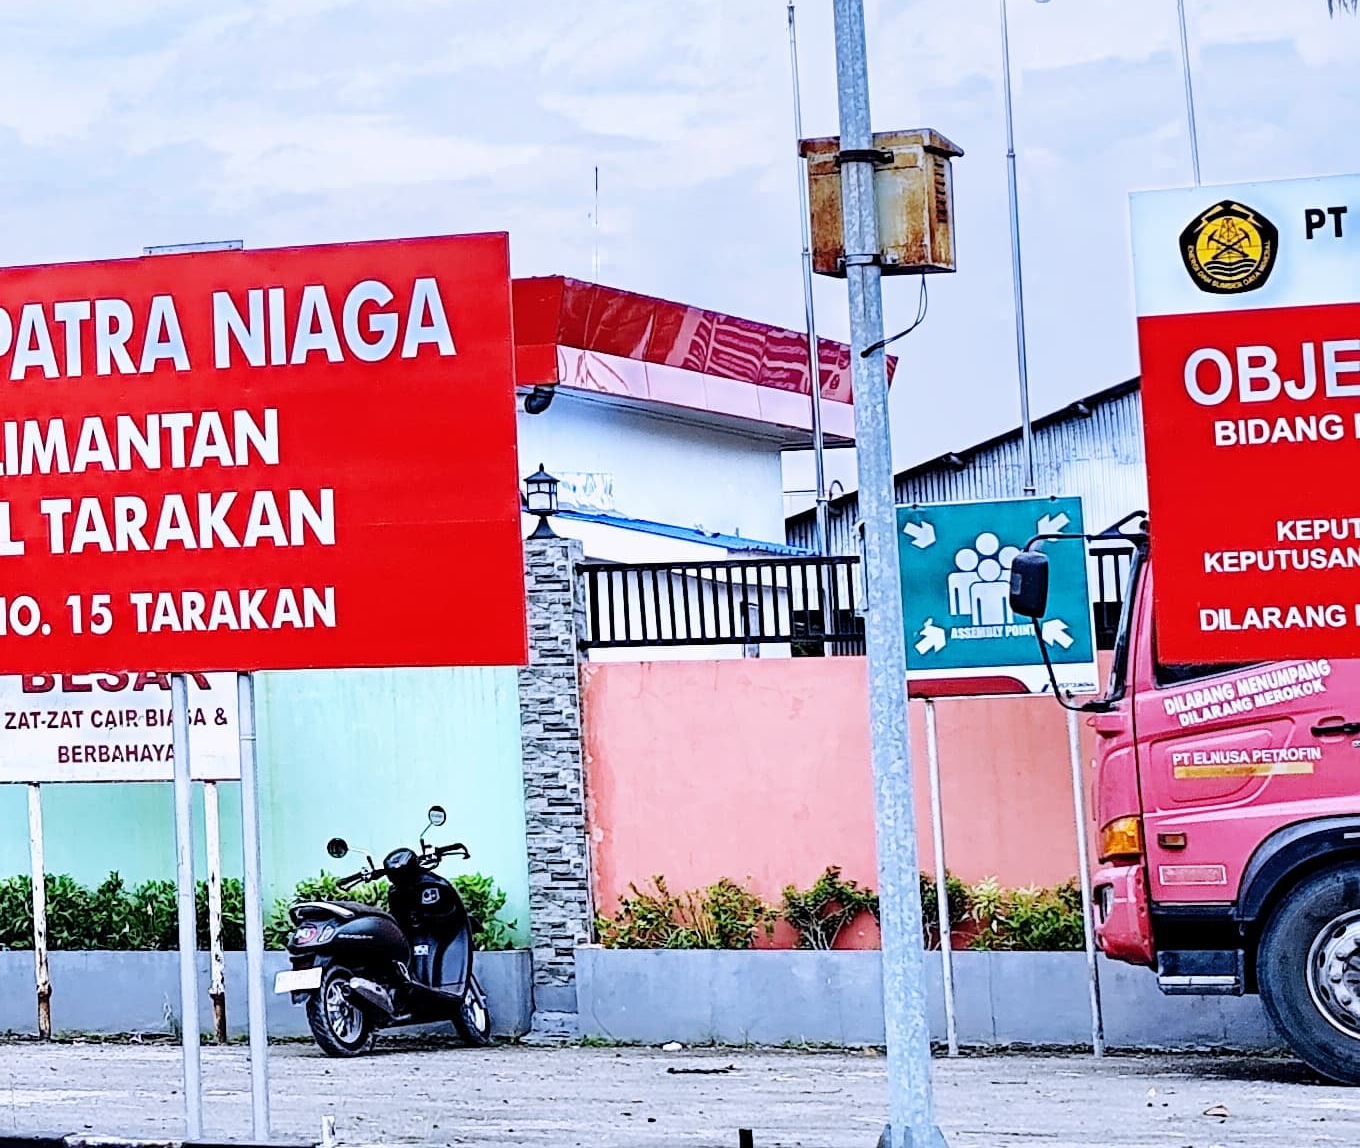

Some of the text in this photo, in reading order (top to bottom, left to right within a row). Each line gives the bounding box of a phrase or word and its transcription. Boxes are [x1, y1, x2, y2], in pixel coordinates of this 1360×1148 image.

[1305, 206, 1347, 239] PT
[213, 277, 457, 369] NIAGA
[1214, 414, 1344, 447] BIDANG
[41, 488, 336, 555] TARAKAN
[1204, 548, 1360, 574] KEPUTUSAN
[67, 593, 113, 635] 15
[131, 586, 336, 633] TARAKAN
[1199, 605, 1346, 632] DILARANG
[951, 625, 1003, 639] ASSEMBLY
[1164, 659, 1331, 715] DILARANG MENUMPANG
[1179, 679, 1326, 727] DILARANG MEROKOK
[4, 710, 84, 730] ZAT-ZAT
[91, 709, 138, 728] CAIR
[214, 707, 228, 726] &
[58, 743, 174, 764] BERBAHAYA
[1172, 747, 1321, 766] PT ELNUSA PETROFIN
